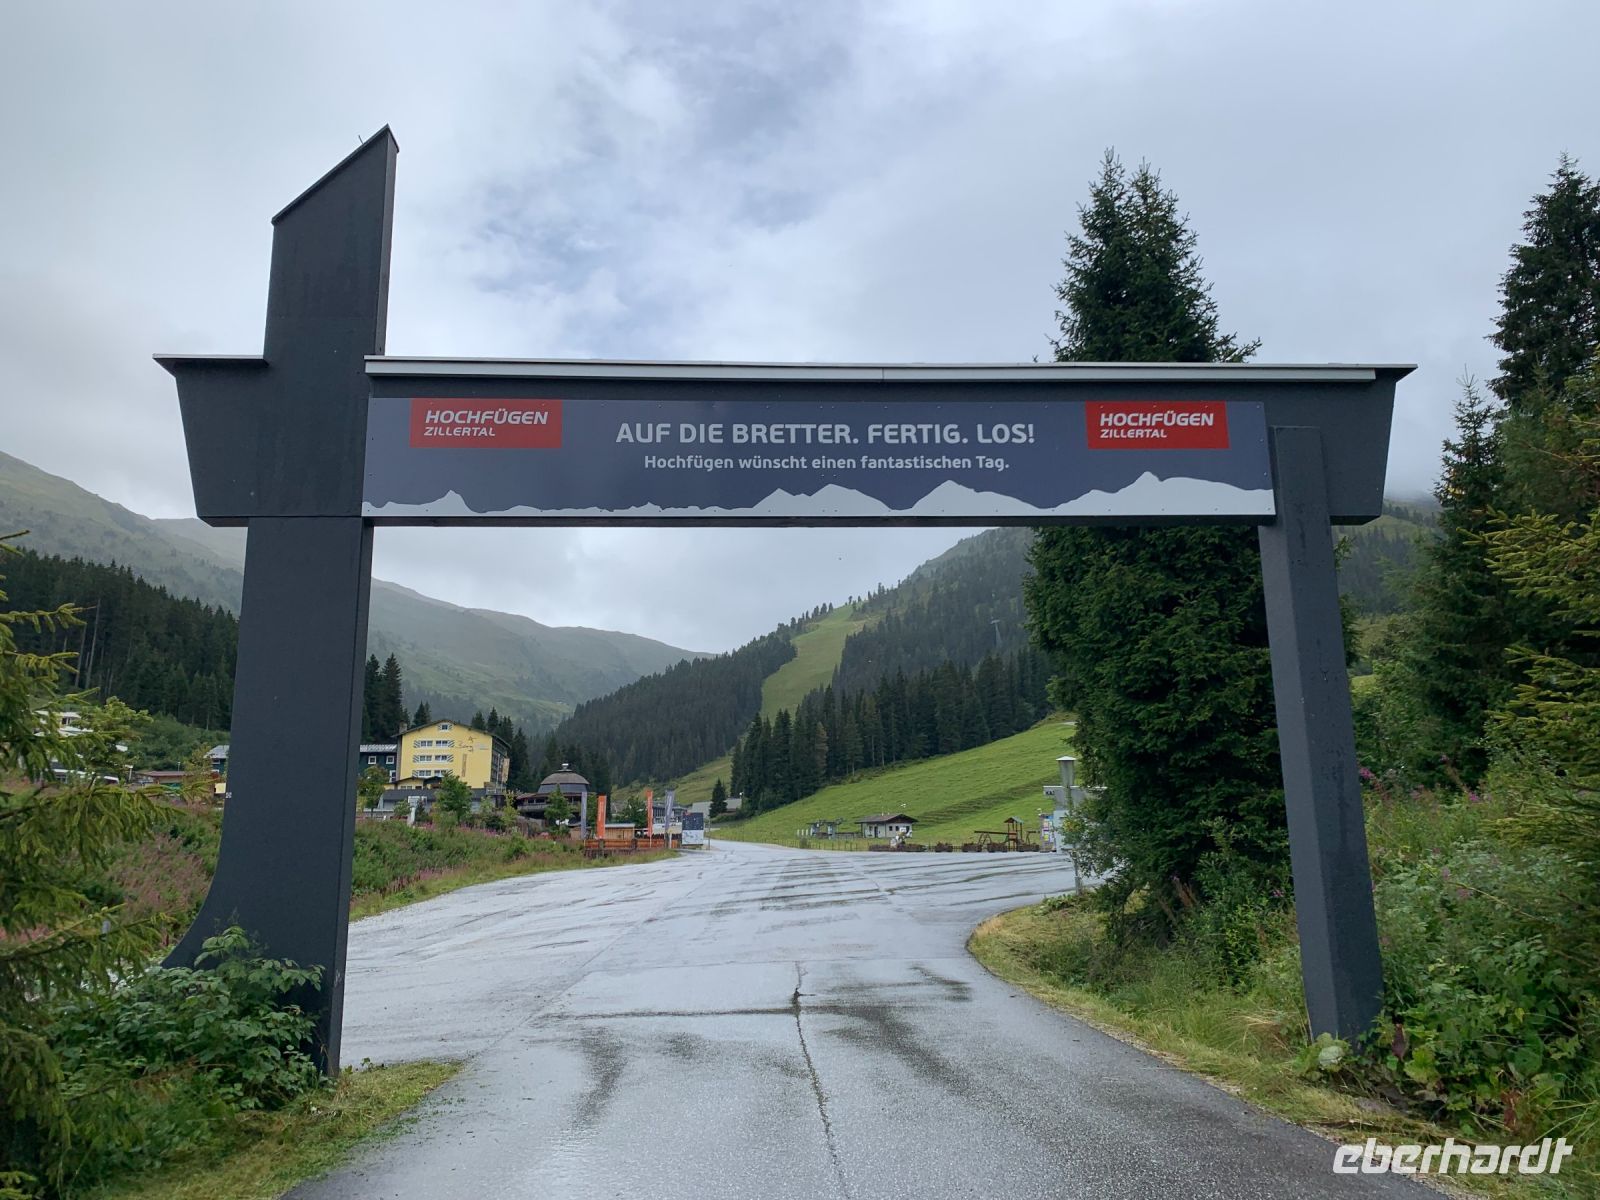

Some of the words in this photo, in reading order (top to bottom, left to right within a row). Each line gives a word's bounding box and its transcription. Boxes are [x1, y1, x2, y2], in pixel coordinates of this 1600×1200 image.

[425, 408, 549, 425] HOCHFÜGEN
[1100, 410, 1214, 426] HOCHFÜGEN
[423, 426, 496, 437] ZILLERTAL
[615, 423, 671, 443] AUF
[679, 423, 724, 444] DIE
[732, 423, 859, 444] BRETTER.
[867, 423, 969, 444] FERTIG.
[977, 423, 1036, 444] LOS!
[1100, 428, 1168, 439] ZILLERTAL
[644, 455, 734, 472] Hochfügen
[738, 455, 808, 469] wünscht
[811, 455, 857, 469] einen
[860, 455, 972, 469] fantastischen
[975, 455, 1010, 472] Tag.
